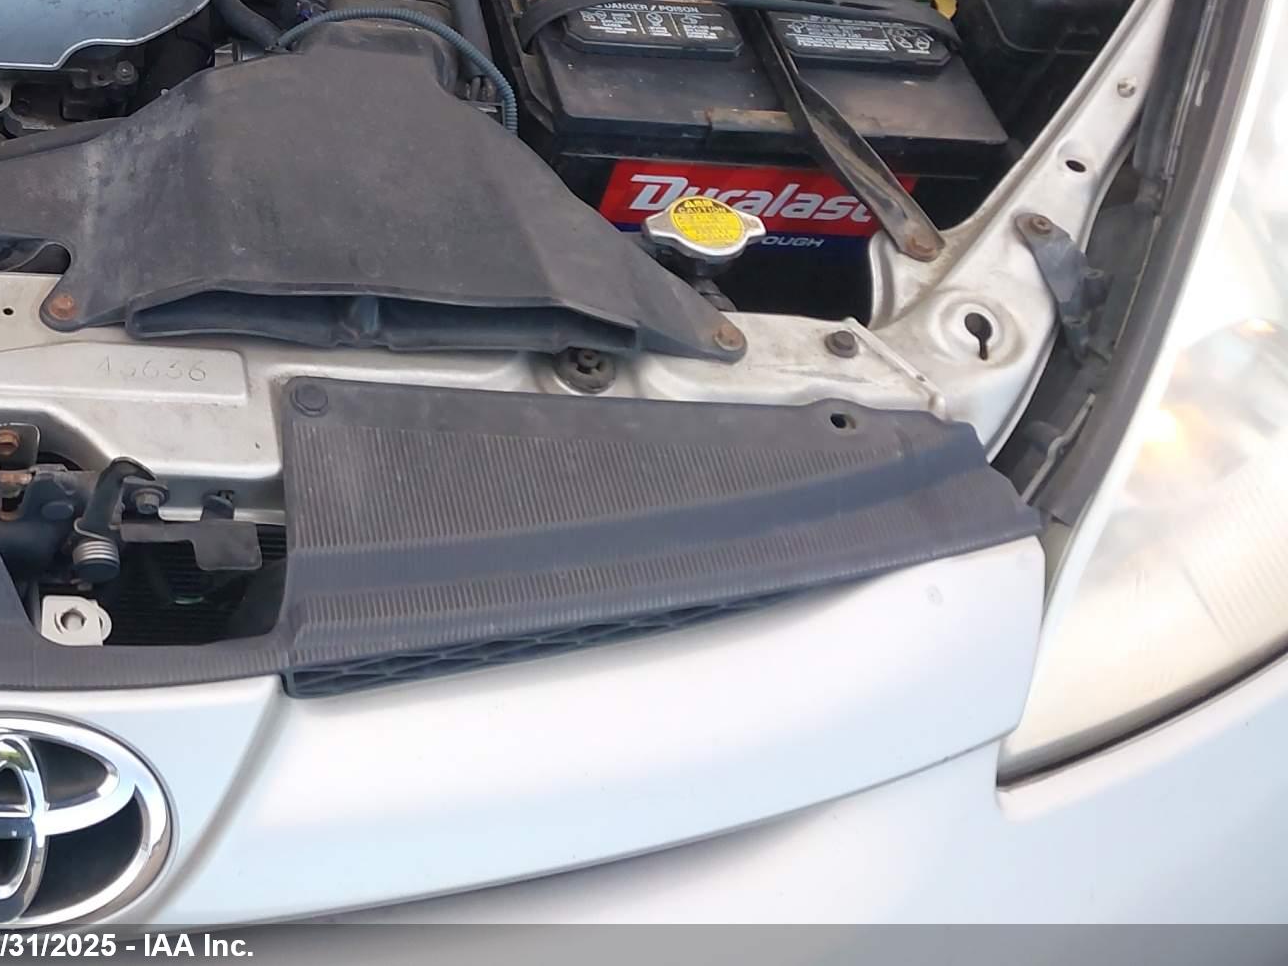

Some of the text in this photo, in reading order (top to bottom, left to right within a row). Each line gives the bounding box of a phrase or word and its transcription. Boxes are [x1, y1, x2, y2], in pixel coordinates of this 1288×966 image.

[604, 3, 648, 11] DANGER
[658, 4, 699, 13] POISON
[761, 236, 825, 248] OUGH
